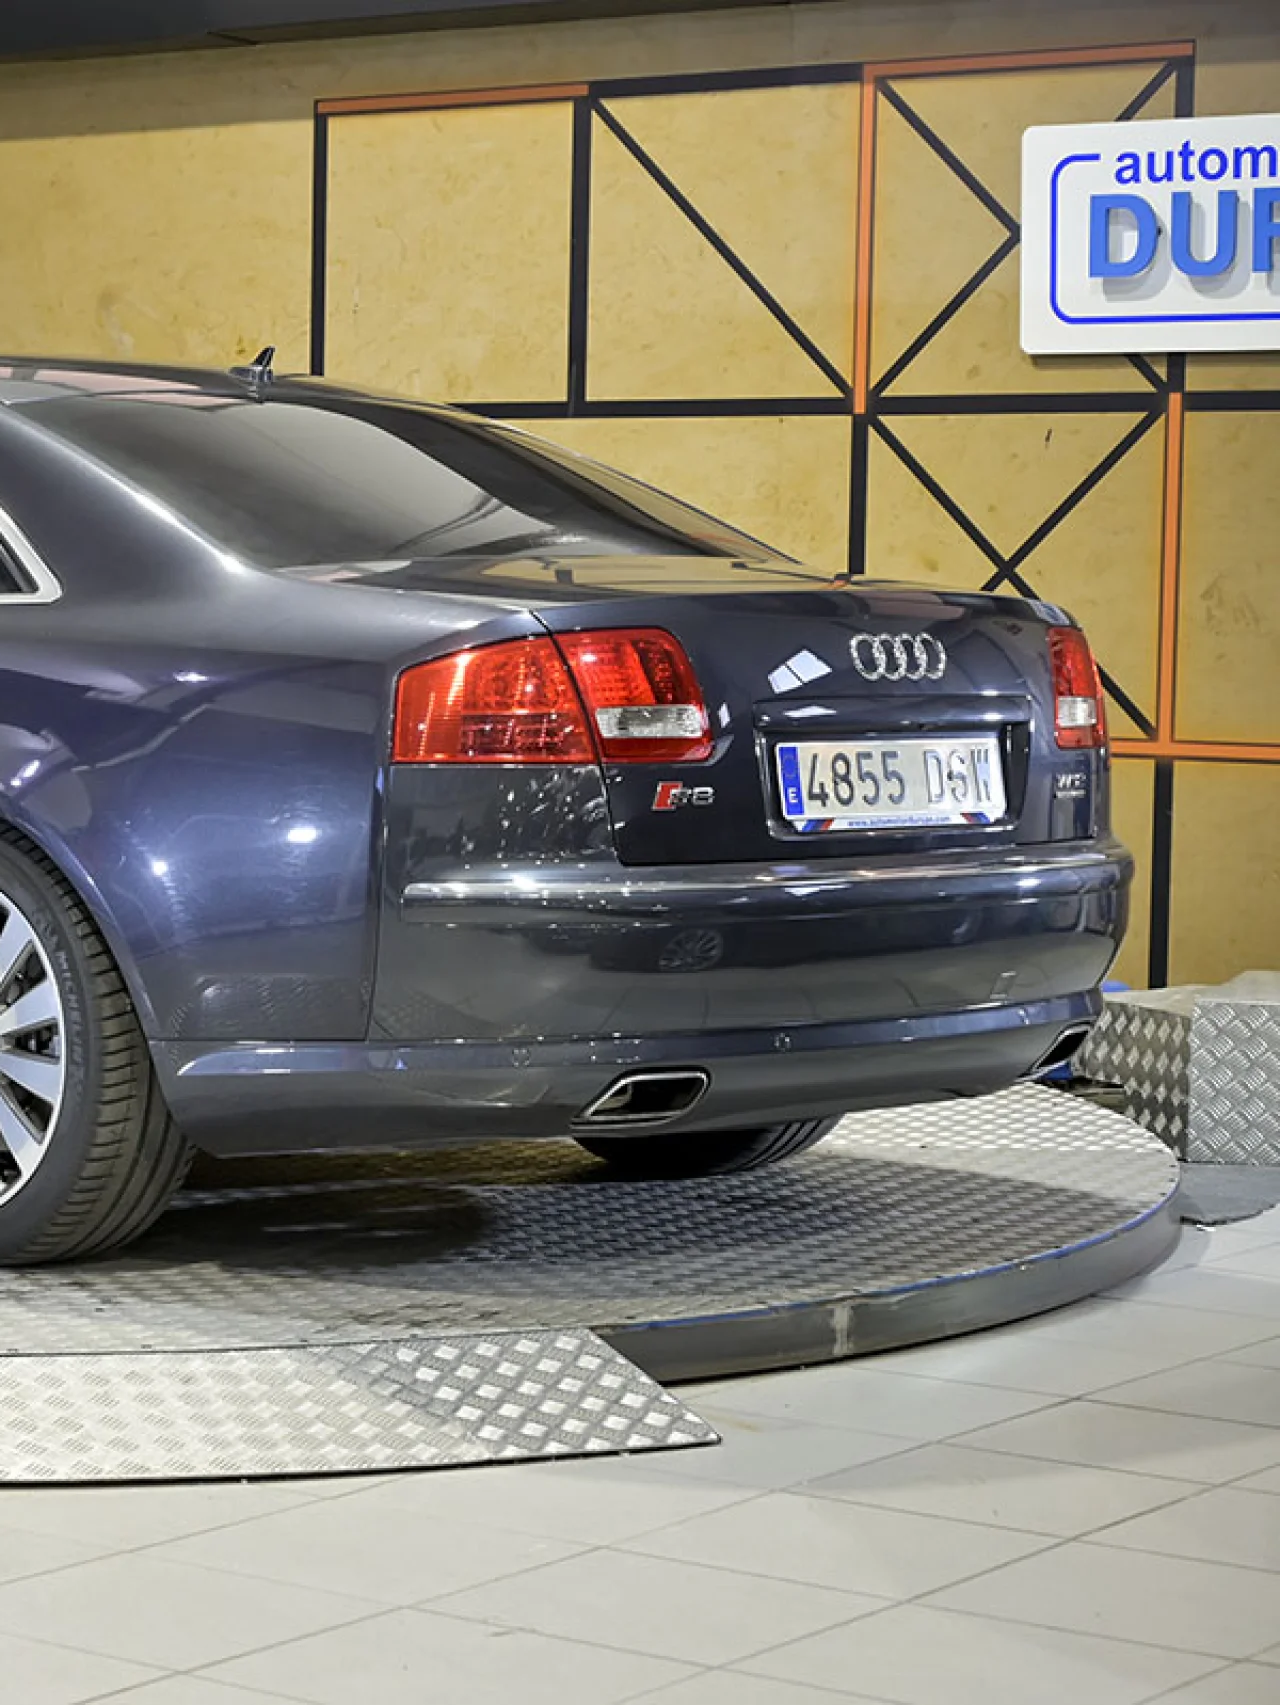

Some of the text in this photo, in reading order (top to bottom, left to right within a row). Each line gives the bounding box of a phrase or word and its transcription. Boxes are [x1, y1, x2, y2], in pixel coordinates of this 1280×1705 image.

[1113, 140, 1279, 185] autom
[788, 787, 799, 803] E
[807, 750, 906, 807] 4855
